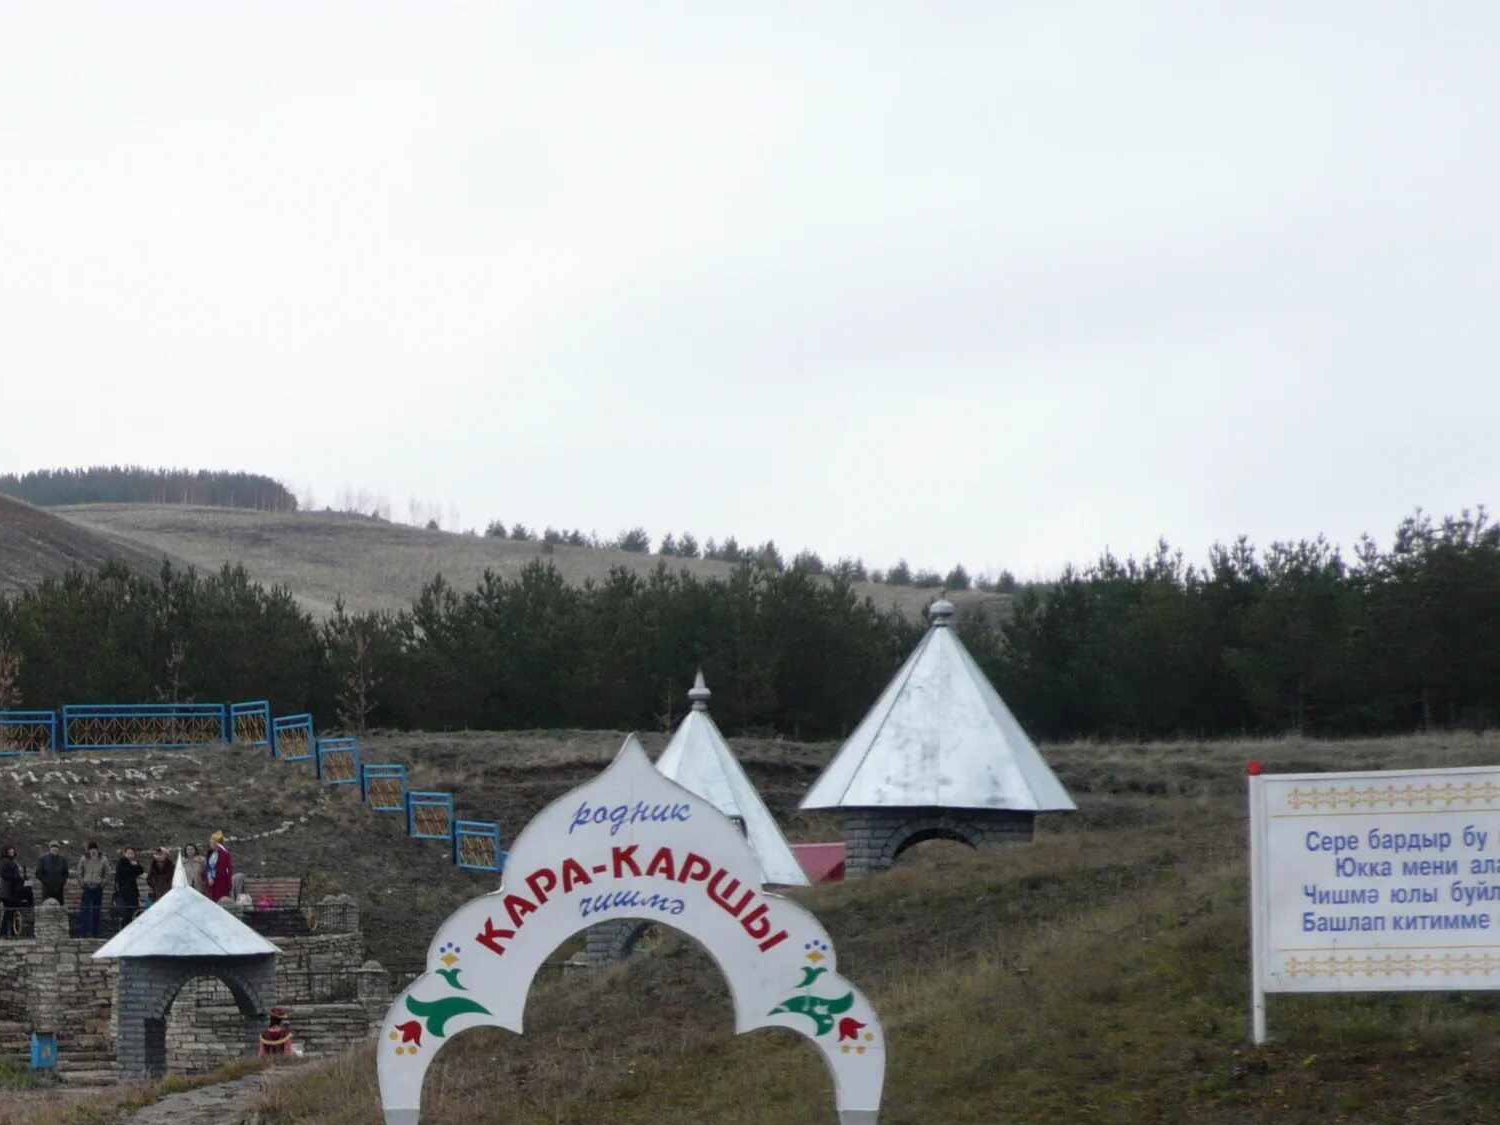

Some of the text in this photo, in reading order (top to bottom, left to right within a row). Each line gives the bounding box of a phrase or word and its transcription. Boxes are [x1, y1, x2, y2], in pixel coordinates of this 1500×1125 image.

[568, 799, 692, 834] родник
[1305, 830, 1359, 855] Сере
[1368, 827, 1451, 855] бардыр
[1463, 825, 1488, 852] бу
[1335, 857, 1392, 878] Юкка
[1402, 858, 1458, 877] мени
[474, 844, 789, 956] КАРА-КАРШЫ
[1303, 884, 1379, 905] Чишмә
[1390, 886, 1438, 904] юлы
[1302, 911, 1490, 932] Башлап китимме
